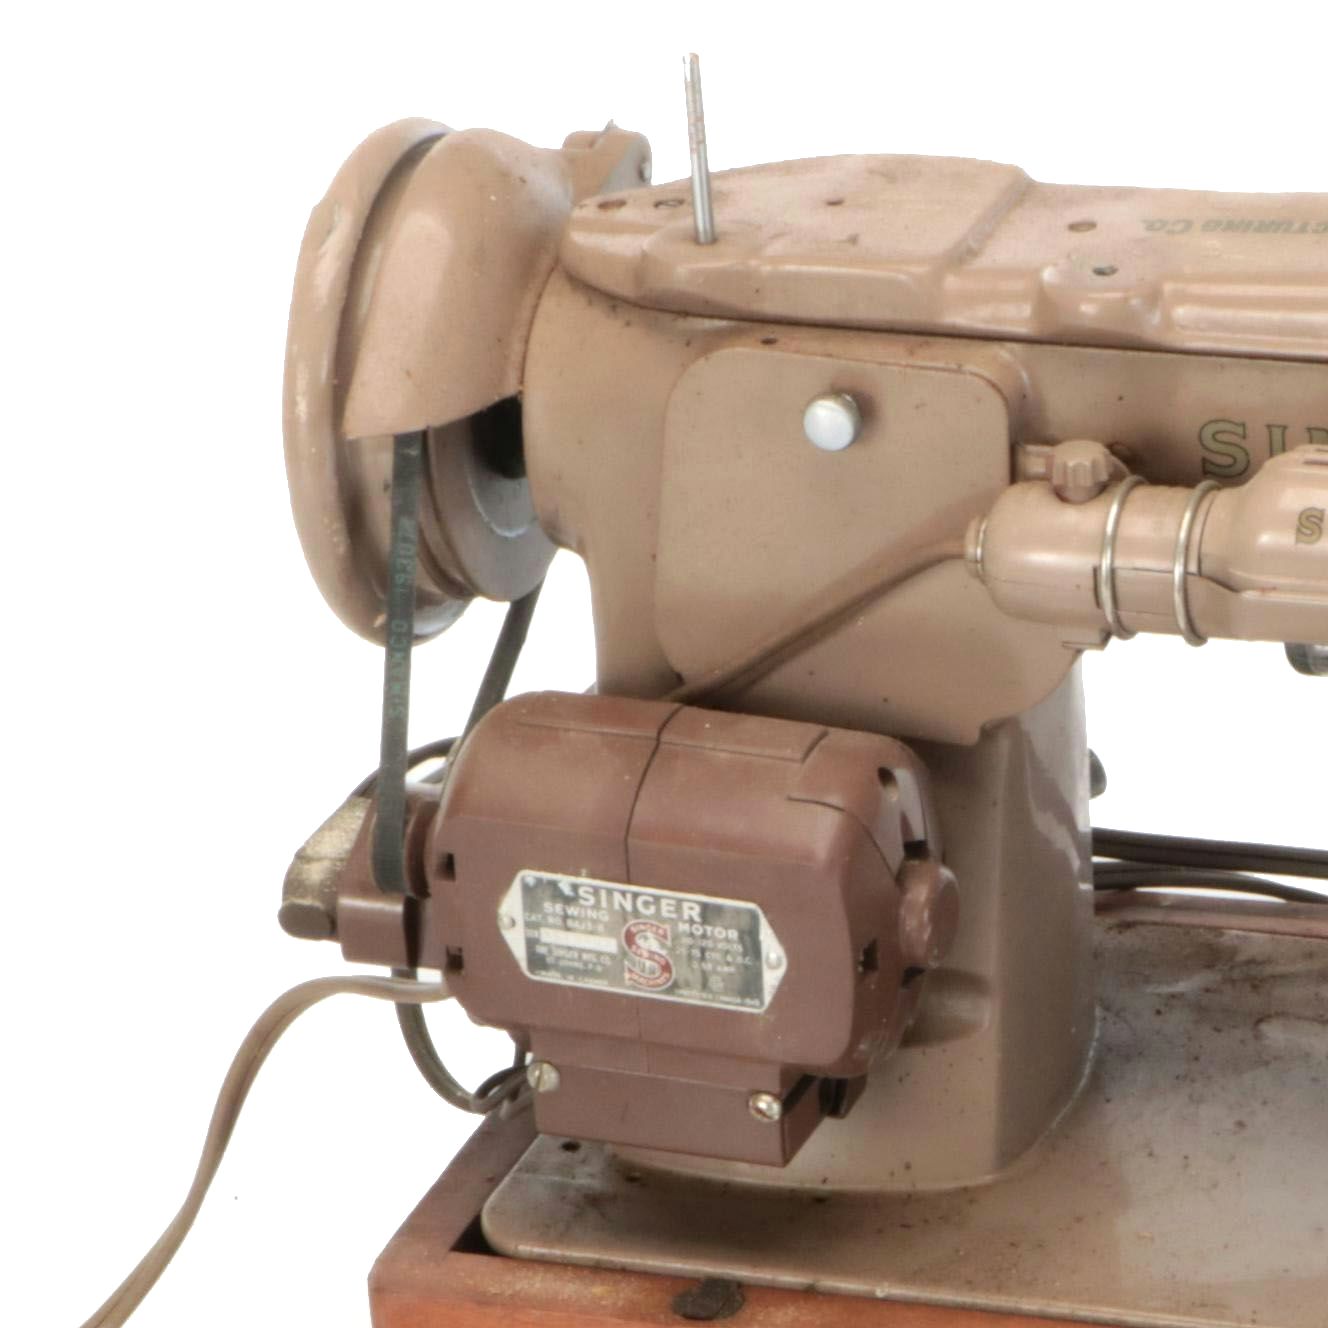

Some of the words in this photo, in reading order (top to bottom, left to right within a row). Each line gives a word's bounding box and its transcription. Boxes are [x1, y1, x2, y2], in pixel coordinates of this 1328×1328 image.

[543, 902, 610, 922] SEWING
[578, 885, 702, 922] SINGER
[678, 921, 739, 941] MOTOR
